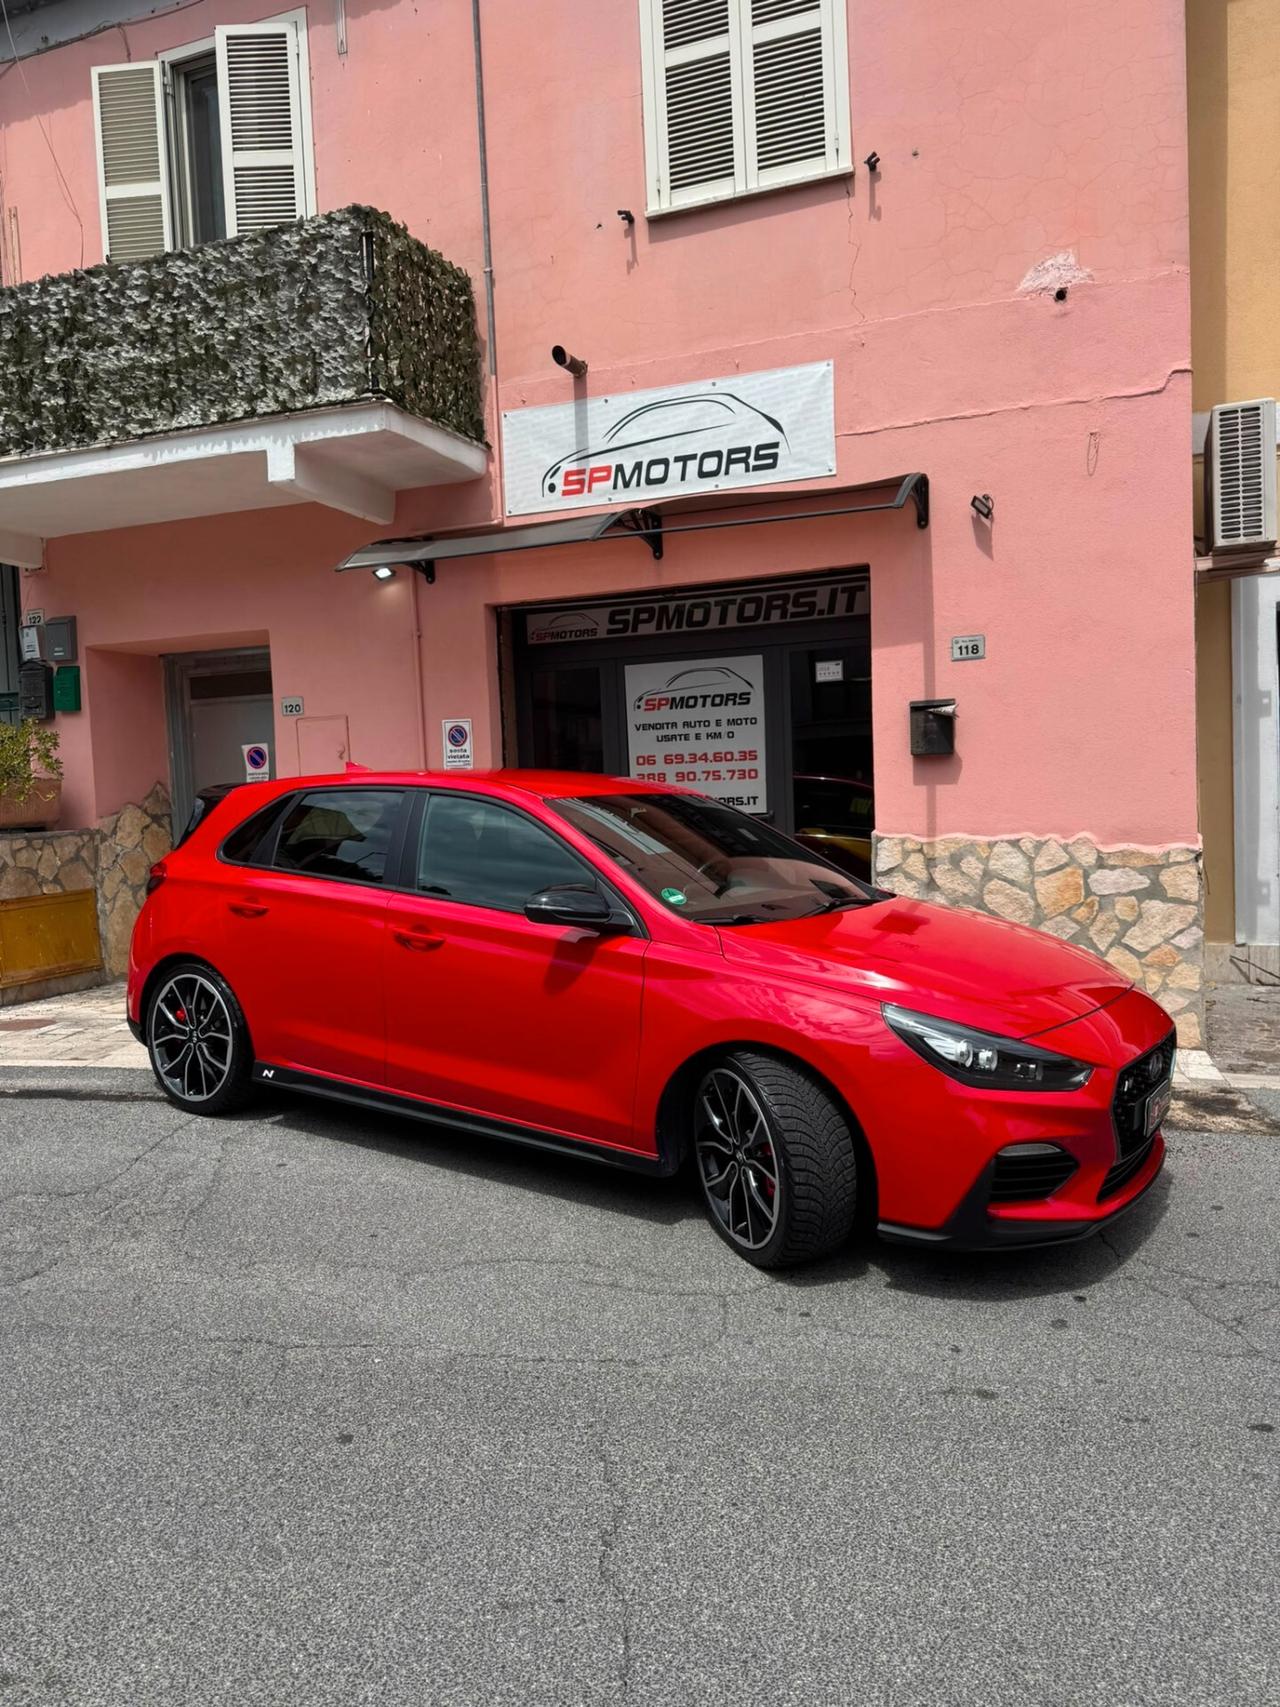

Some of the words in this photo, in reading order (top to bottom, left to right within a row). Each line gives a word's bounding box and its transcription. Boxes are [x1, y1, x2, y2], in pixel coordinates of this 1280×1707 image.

[561, 441, 780, 497] SPMOTORS
[606, 584, 867, 635] SPMOTORS.IT
[958, 644, 980, 656] 118
[284, 703, 301, 713] 120
[643, 692, 751, 712] SPMOTORS
[634, 721, 678, 732] VENDITA
[682, 719, 711, 729] AUTO
[715, 719, 722, 727] E
[726, 717, 757, 726] MOTO
[656, 733, 690, 743] USATE
[695, 732, 701, 741] E
[706, 731, 722, 740] KM
[636, 755, 656, 766] 06
[663, 750, 758, 765] 69.34.60.35
[675, 768, 758, 782] 90.75.730
[262, 1069, 275, 1078] N
